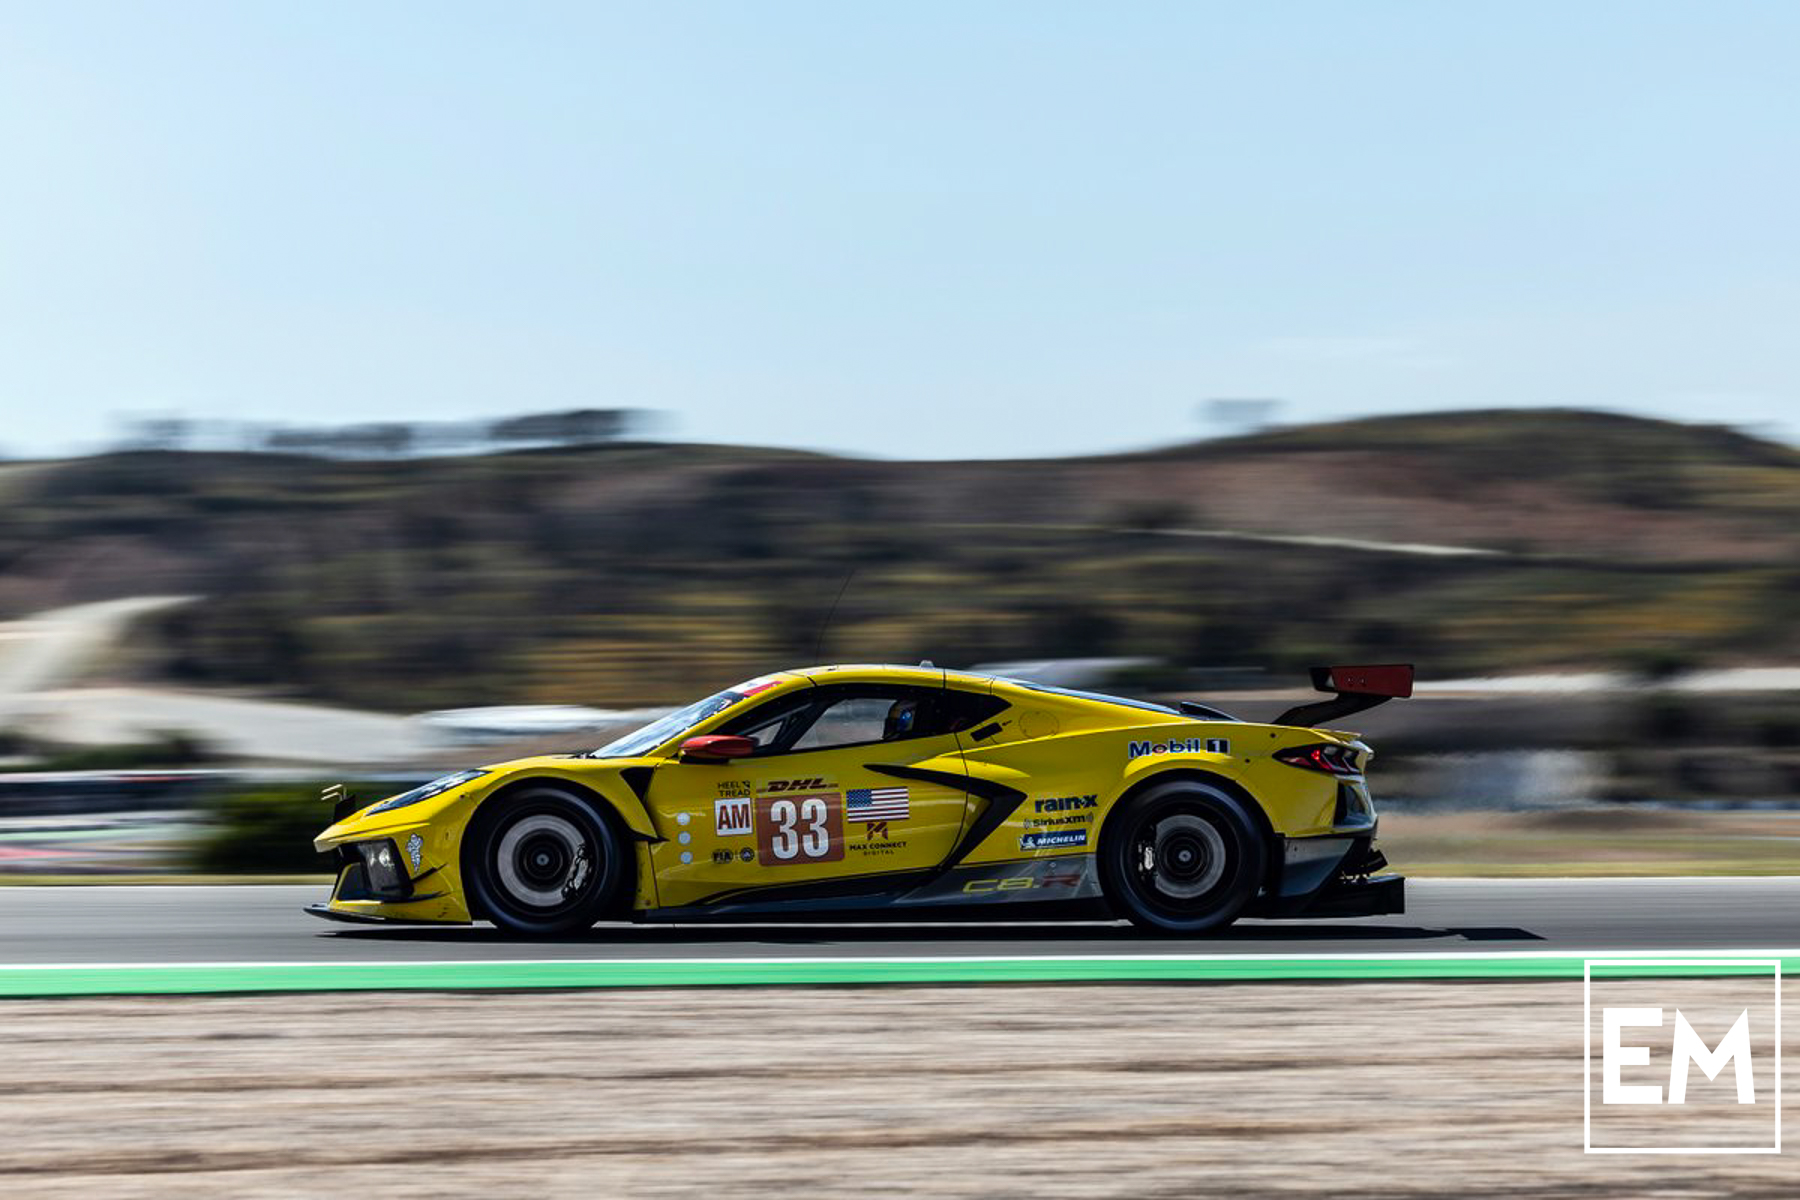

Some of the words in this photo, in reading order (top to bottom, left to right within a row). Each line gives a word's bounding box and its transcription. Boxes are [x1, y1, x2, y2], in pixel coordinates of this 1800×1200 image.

[1129, 739, 1199, 758] Mobil
[718, 781, 740, 789] HEEL
[767, 779, 827, 792] DHL
[720, 789, 750, 797] TREAD
[718, 804, 750, 829] AM
[771, 799, 829, 859] 33
[869, 841, 907, 850] CONNECT
[1036, 834, 1086, 846] MICHELIN
